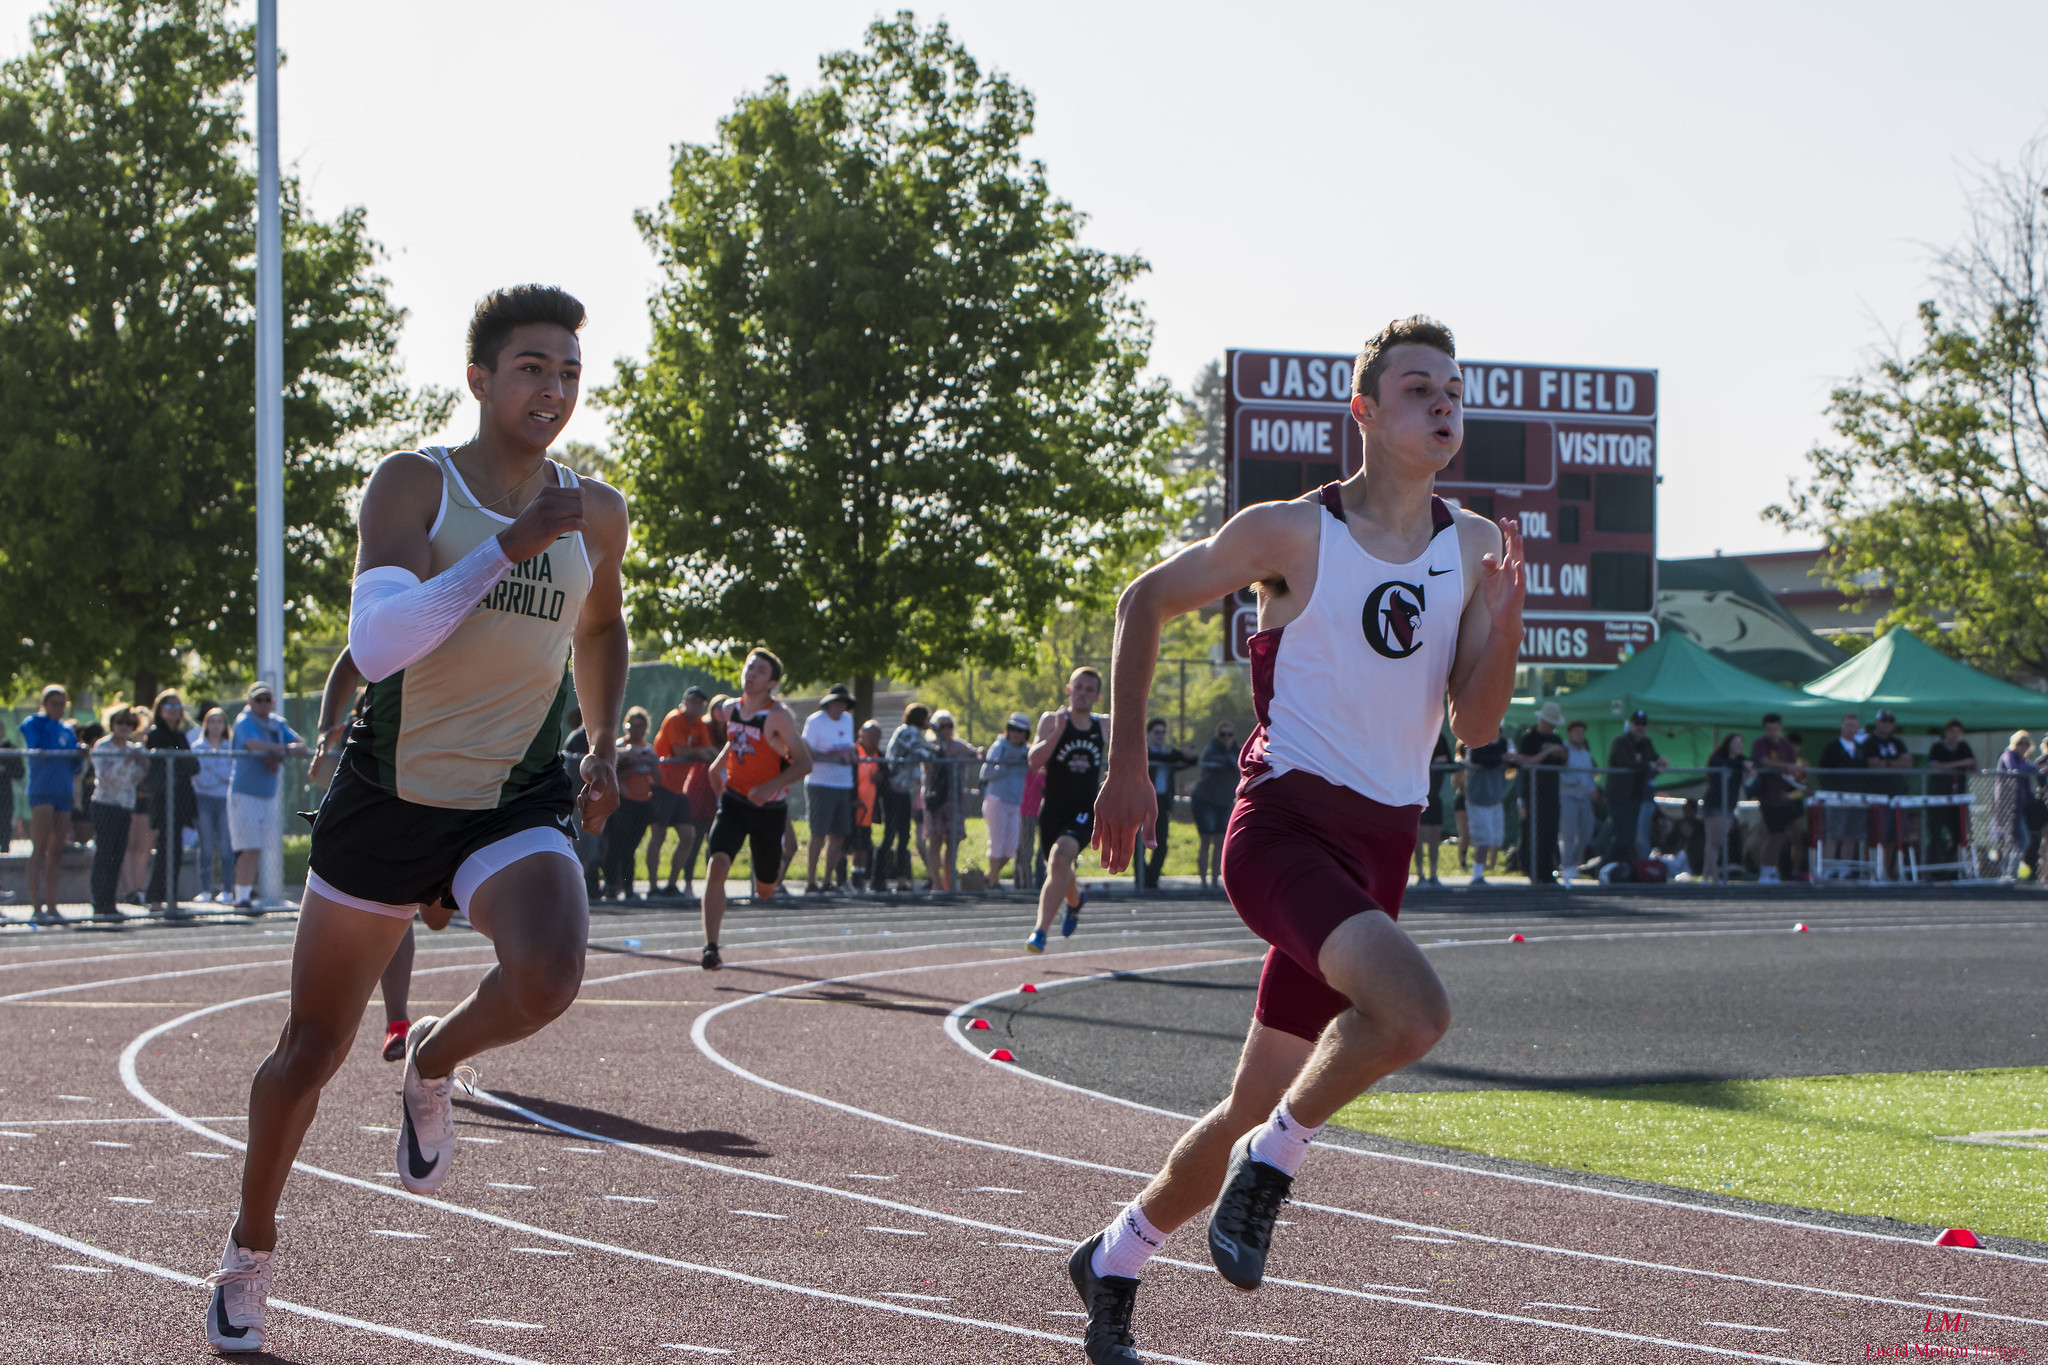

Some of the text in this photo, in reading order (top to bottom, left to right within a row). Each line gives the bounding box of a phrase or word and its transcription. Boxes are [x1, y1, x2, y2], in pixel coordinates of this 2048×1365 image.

[1260, 357, 1636, 412] JASO NCI FIELD
[1250, 418, 1333, 455] HOME
[1558, 431, 1651, 467] VISITOR
[1519, 510, 1551, 539] TOL
[510, 552, 553, 583] RIA
[1559, 563, 1587, 597] ON
[476, 579, 565, 622] ARRILLO
